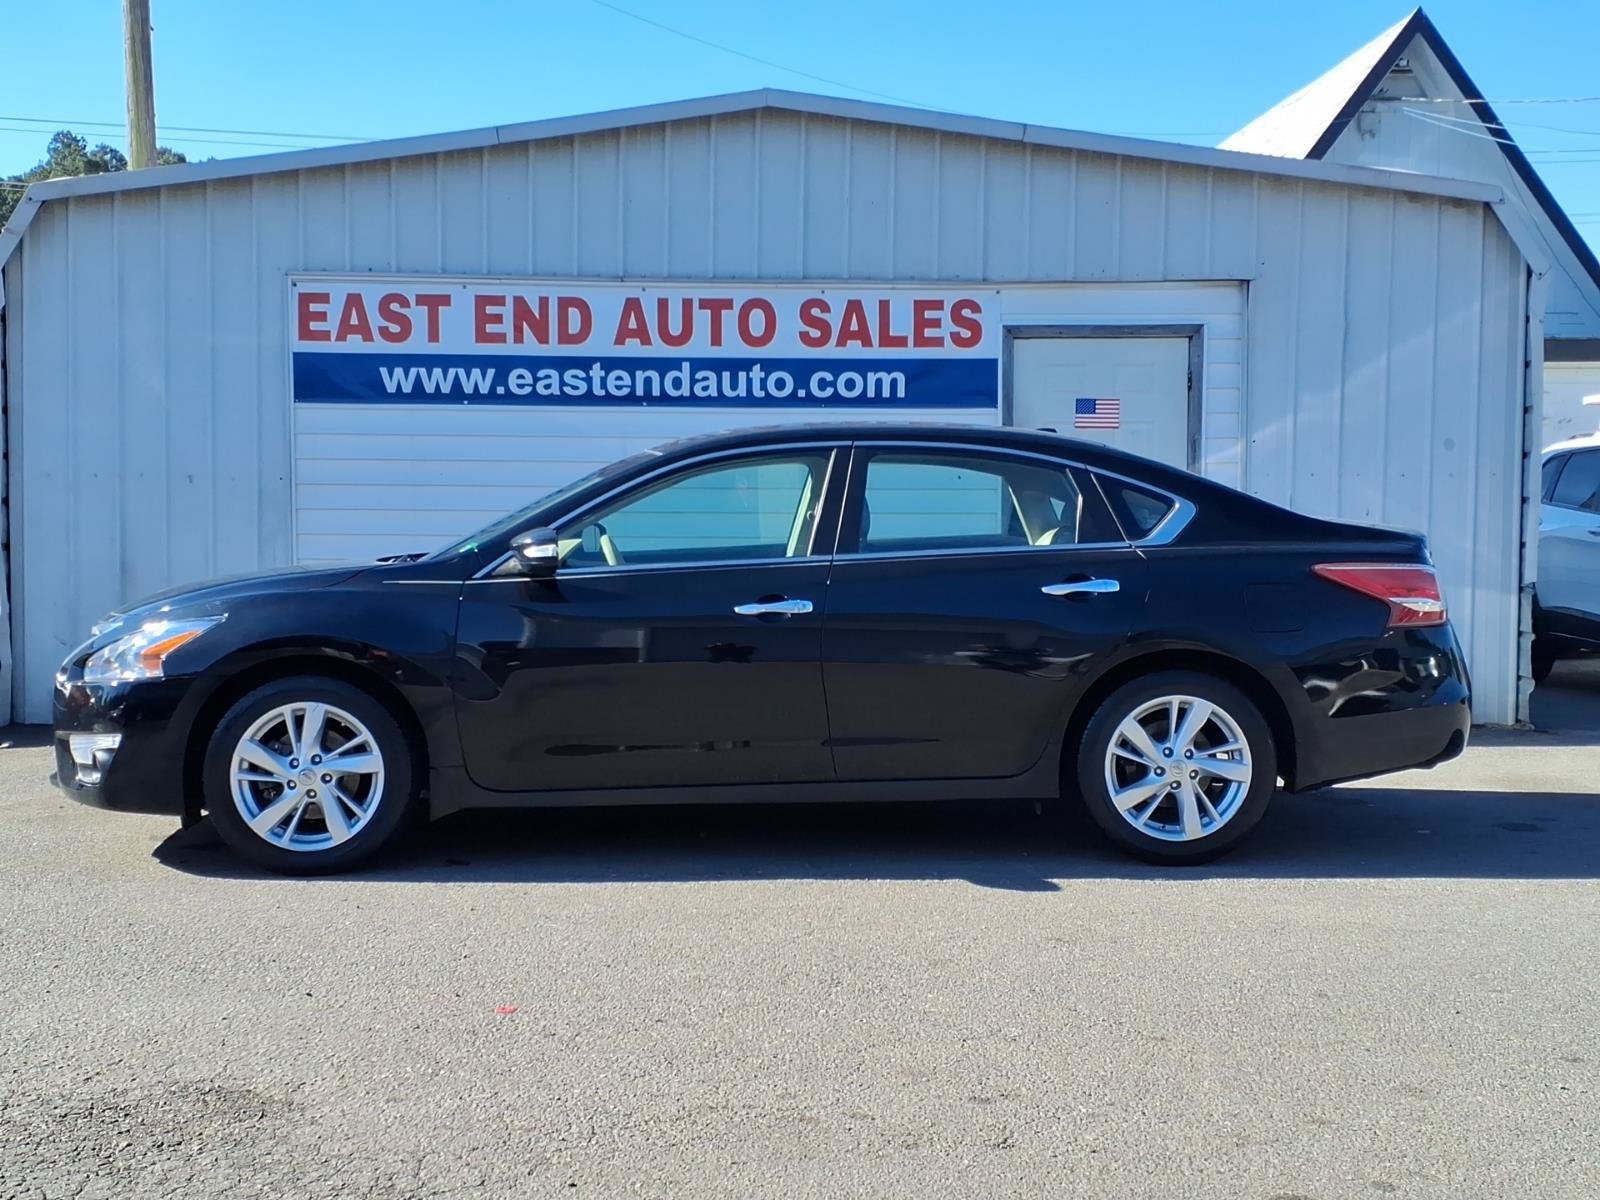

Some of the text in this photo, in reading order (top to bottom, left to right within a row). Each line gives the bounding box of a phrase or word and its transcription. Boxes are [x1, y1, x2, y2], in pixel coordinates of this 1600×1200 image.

[298, 292, 983, 349] EAST END AUTO SALES
[379, 361, 906, 398] www.eastendauto.com
